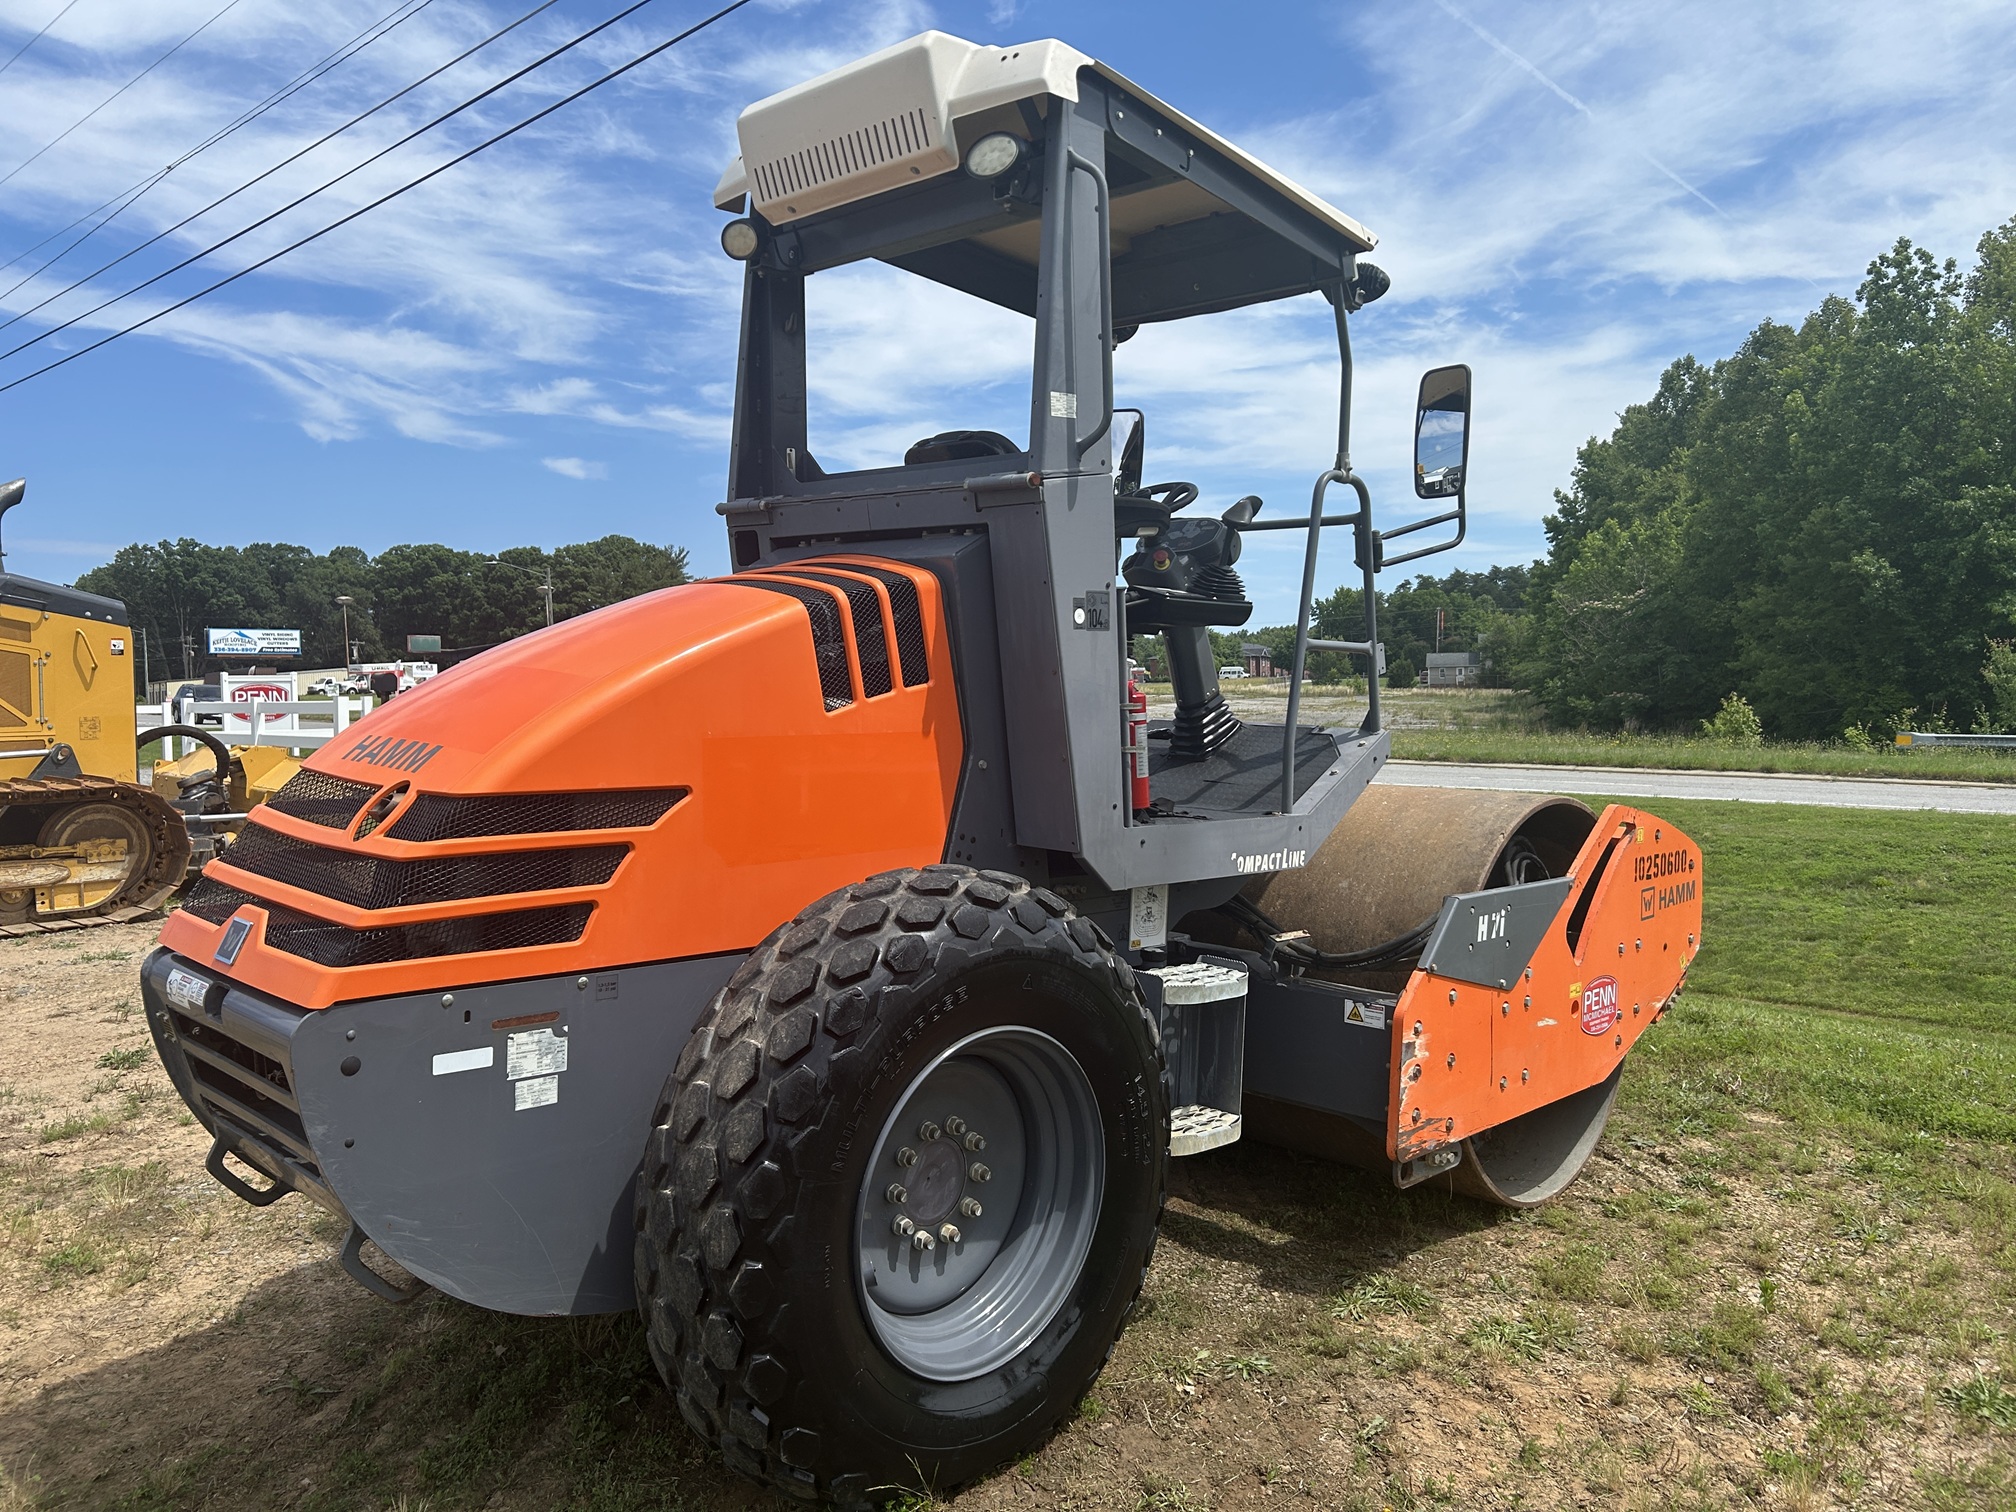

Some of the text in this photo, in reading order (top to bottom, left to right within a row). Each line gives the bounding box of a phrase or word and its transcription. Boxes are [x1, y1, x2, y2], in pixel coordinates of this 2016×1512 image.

[213, 637, 258, 647] KEITH LOVELACE
[341, 735, 444, 774] HAMM
[1634, 849, 1687, 883] 10250600
[1658, 880, 1696, 911] HAMM
[1584, 983, 1616, 1014] PENN
